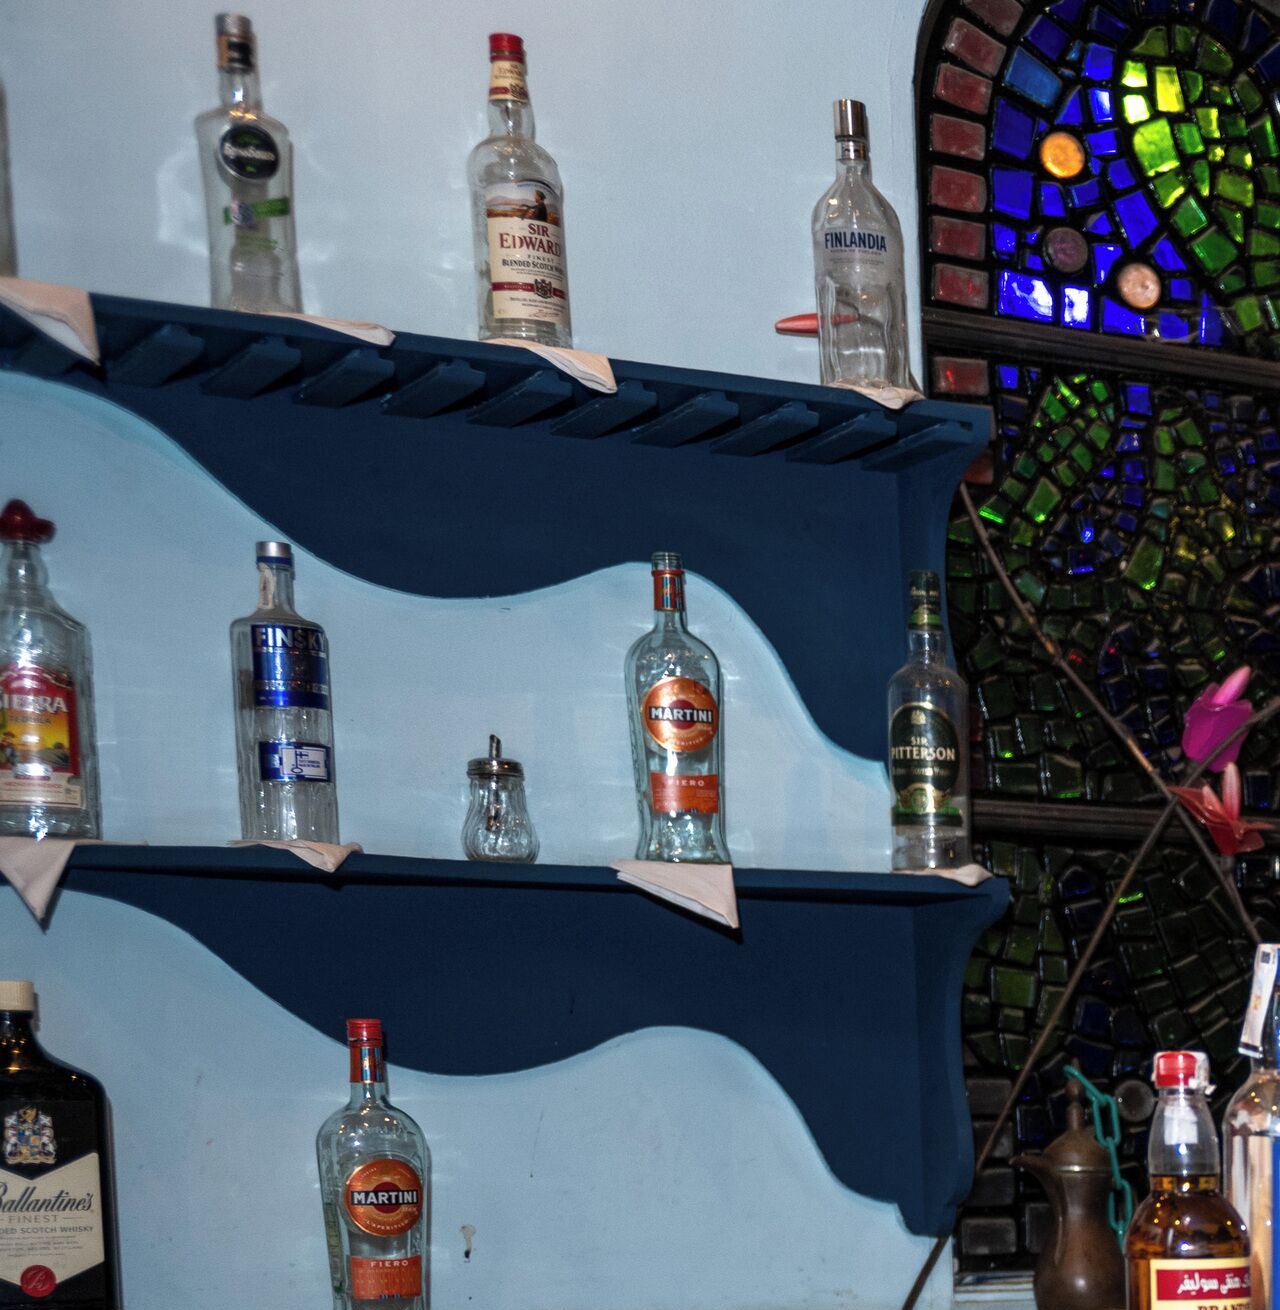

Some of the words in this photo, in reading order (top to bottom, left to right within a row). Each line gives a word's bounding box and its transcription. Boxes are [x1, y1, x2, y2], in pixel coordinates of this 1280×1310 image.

[528, 223, 550, 237] SIR
[824, 231, 887, 252] FINLANDIA
[502, 259, 531, 268] BLENDED
[532, 260, 553, 272] SCOTCH
[255, 627, 325, 651] FINSKY
[0, 693, 69, 713] IERRA
[651, 707, 712, 722] MARTINI
[911, 736, 928, 746] SIR
[353, 1191, 417, 1204] MARTINI
[8, 1214, 59, 1223] FINEST
[20, 1226, 57, 1234] SCOTCH
[60, 1225, 94, 1233] WHISKY
